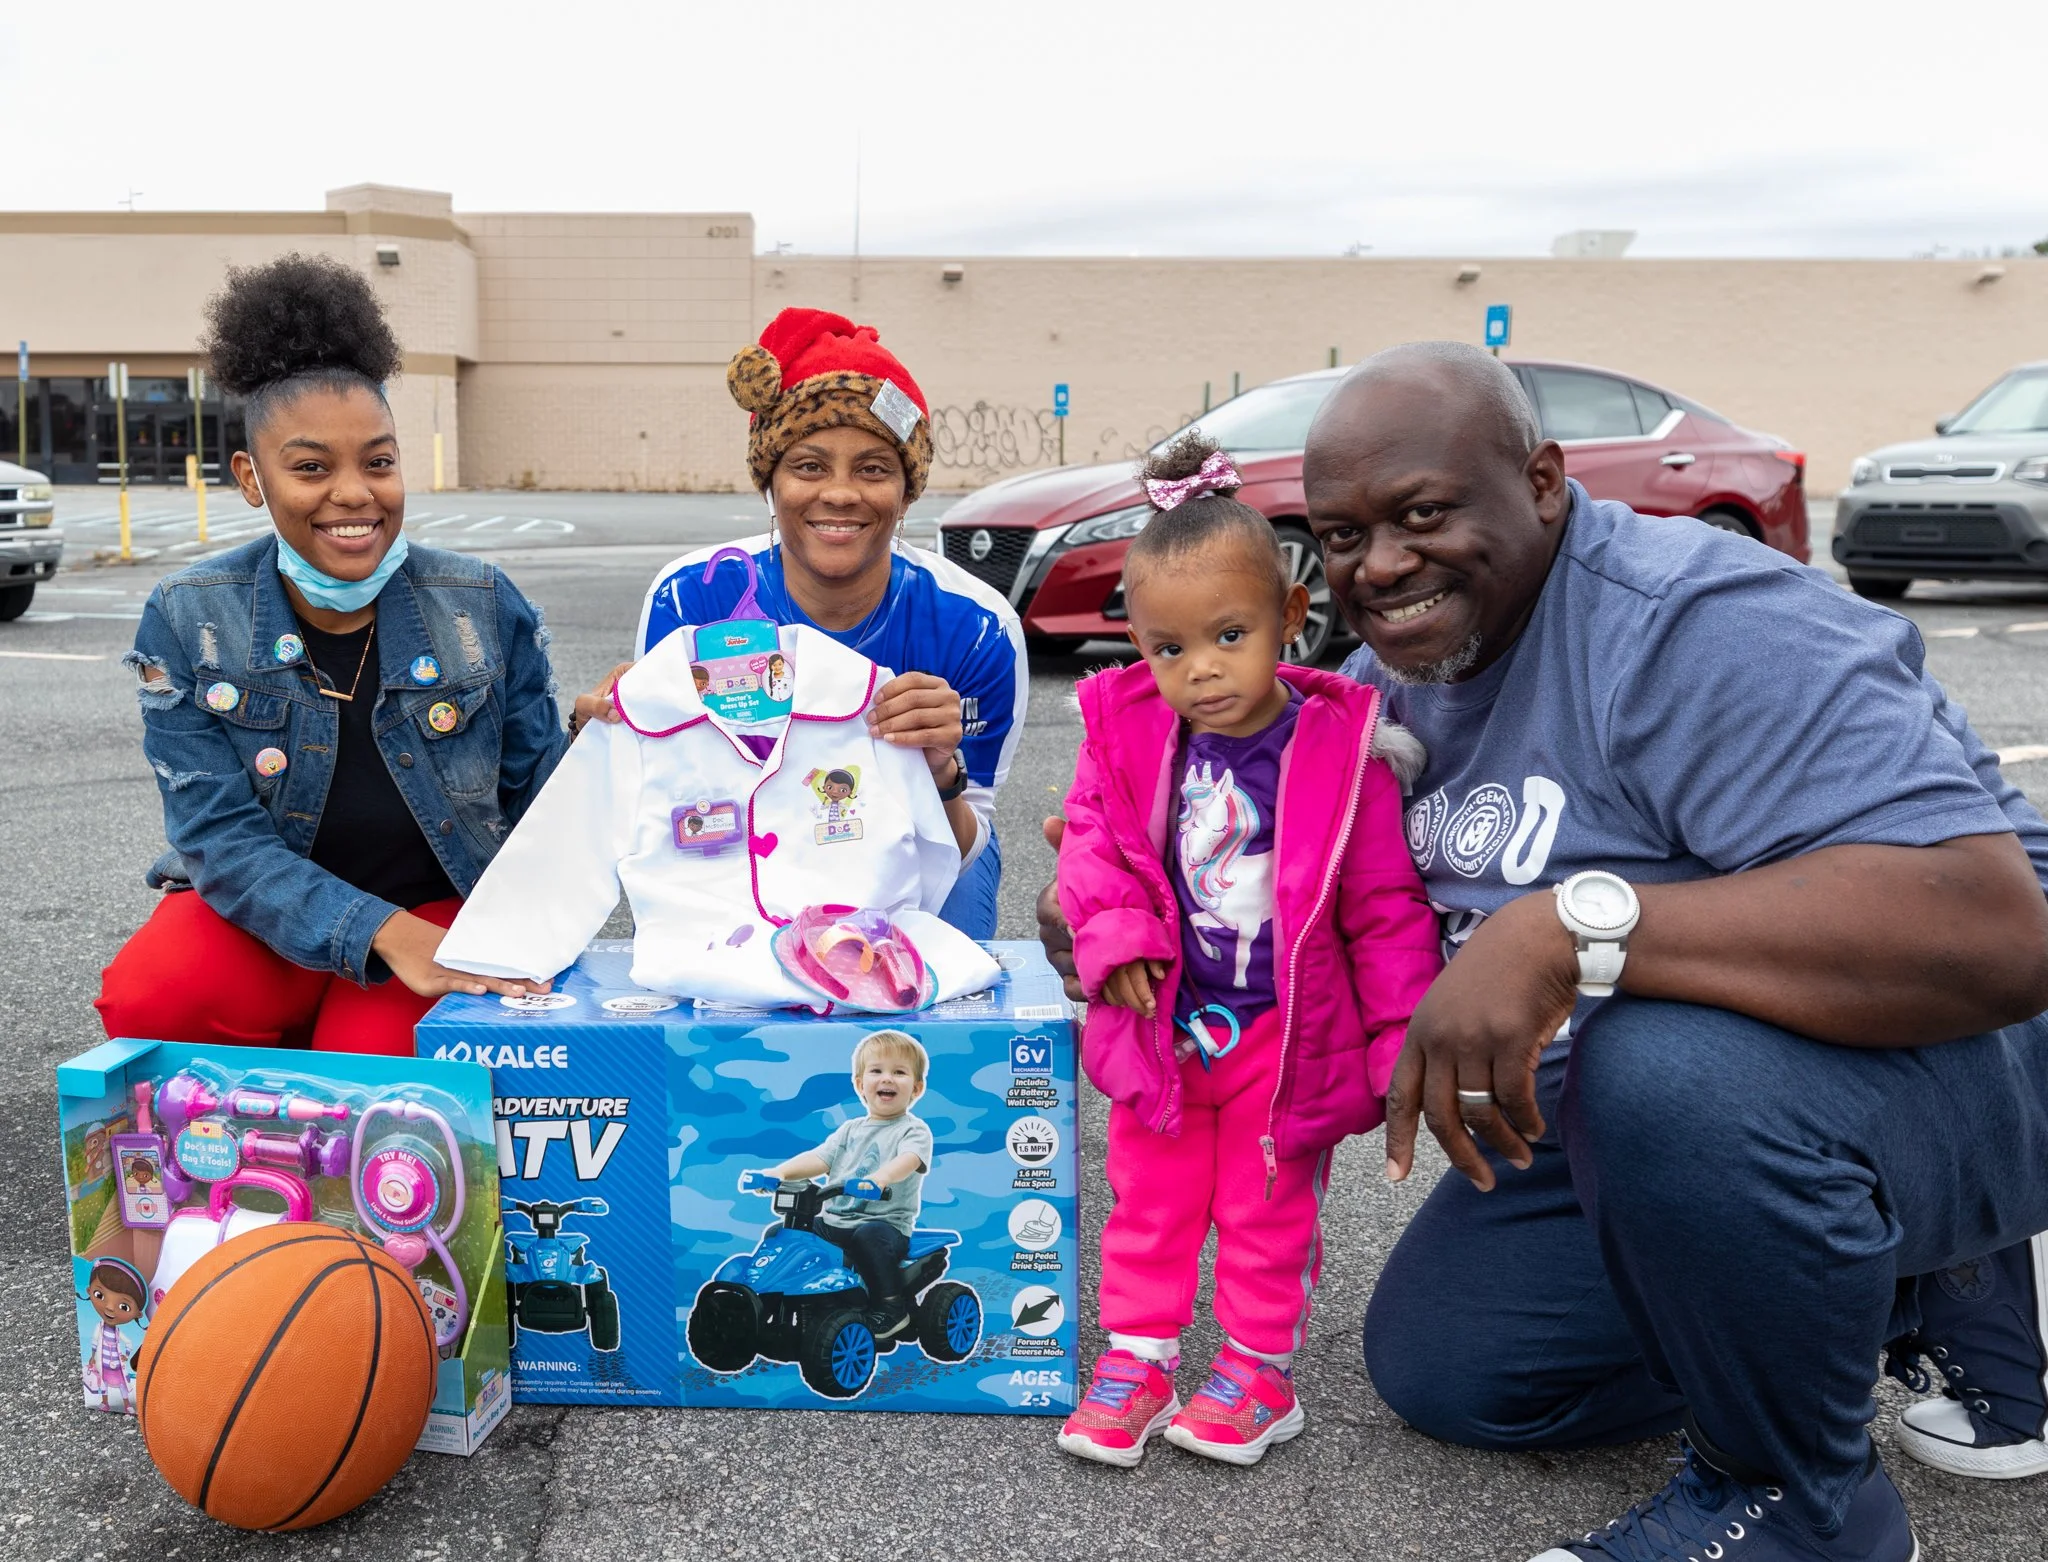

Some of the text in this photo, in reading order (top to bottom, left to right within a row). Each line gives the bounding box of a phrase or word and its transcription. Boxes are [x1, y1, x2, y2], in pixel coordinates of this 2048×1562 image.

[706, 225, 739, 239] 4701
[726, 694, 751, 703] Doctor's
[720, 702, 738, 710] Dress
[738, 701, 748, 709] Up
[1475, 790, 1505, 805] GEM
[1427, 793, 1443, 851] ELEVATION
[1484, 798, 1511, 855] ELEVATION
[1447, 846, 1483, 872] MATURITY
[475, 1045, 568, 1069] KALEE
[1015, 1078, 1049, 1086] Includes
[1008, 1088, 1020, 1096] 6V
[1020, 1088, 1050, 1098] Battery
[494, 1097, 631, 1117] ADVENTURE
[1007, 1099, 1058, 1109] Wall Charger
[184, 1141, 229, 1154] Doc's NEW
[1019, 1145, 1047, 1153] 1.6 MPH
[182, 1153, 199, 1165] Bag
[206, 1156, 232, 1168] Tools!
[377, 1151, 417, 1166] TRY ME!
[1018, 1170, 1050, 1178] 1.6 MPH
[1014, 1180, 1056, 1190] Max Speed
[370, 1201, 383, 1216] Light
[386, 1215, 404, 1226] Sound
[1015, 1252, 1057, 1262] Easy Pedal
[1011, 1262, 1062, 1272] Drive System
[1016, 1338, 1050, 1346] Forward
[1012, 1348, 1065, 1356] Reverse Mode
[517, 1360, 582, 1372] WARNING:
[544, 1379, 568, 1387] required.
[1008, 1369, 1063, 1387] AGES
[616, 1388, 635, 1396] during
[1019, 1390, 1052, 1407] 2-5
